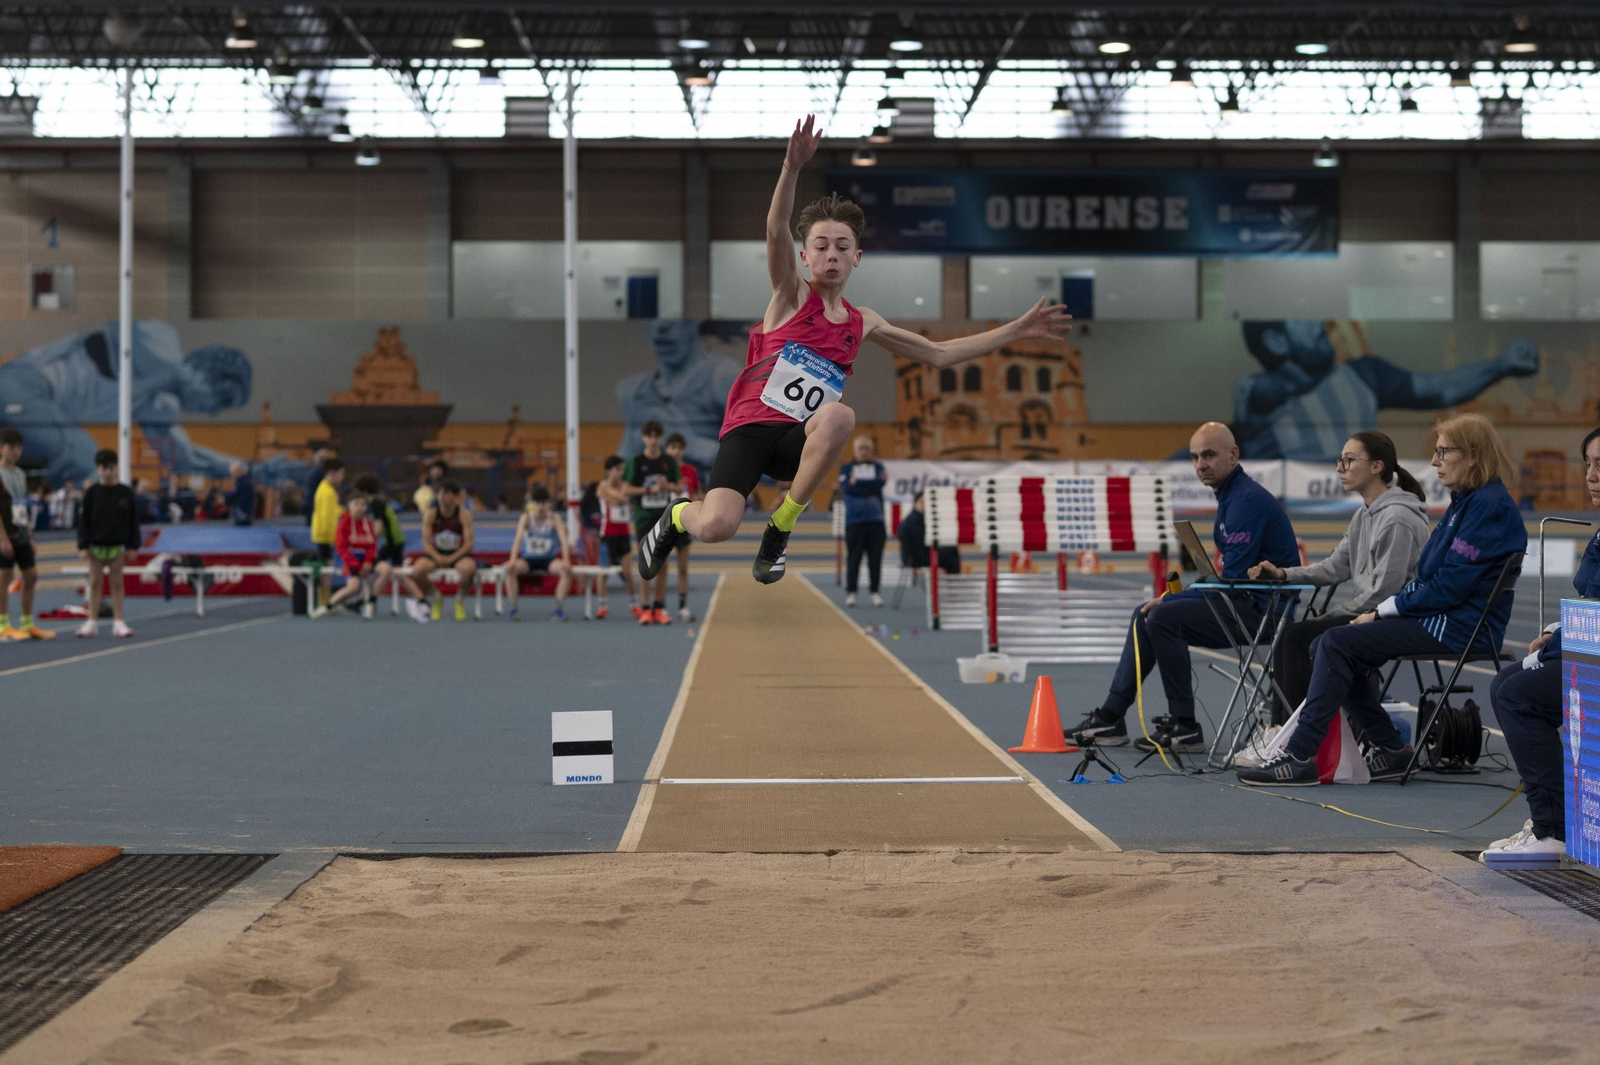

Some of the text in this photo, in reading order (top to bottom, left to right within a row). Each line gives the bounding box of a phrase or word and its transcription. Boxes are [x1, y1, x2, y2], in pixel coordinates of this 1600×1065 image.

[985, 196, 1191, 229] OURENSE
[805, 361, 832, 378] Atletismo
[783, 376, 825, 412] 60
